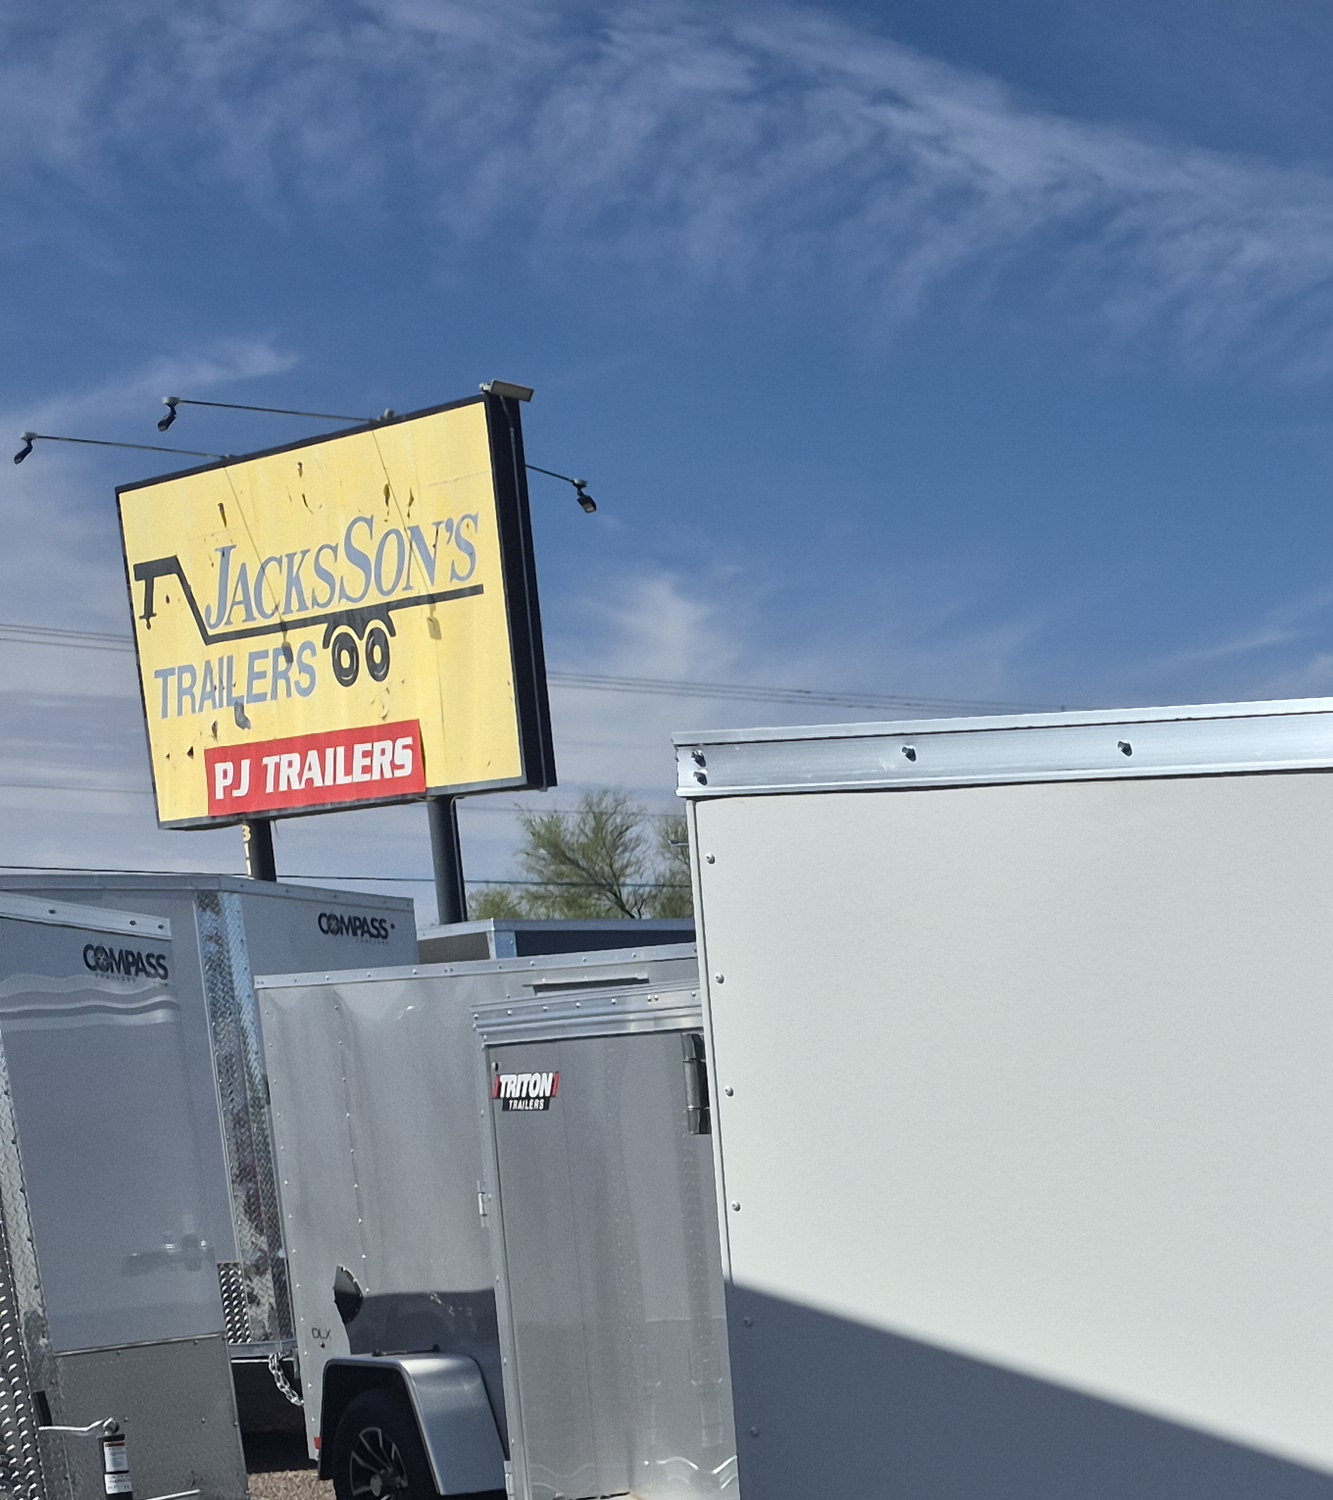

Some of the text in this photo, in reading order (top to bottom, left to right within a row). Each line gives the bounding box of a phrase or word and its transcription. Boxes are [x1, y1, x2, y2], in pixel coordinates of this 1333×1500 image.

[154, 640, 318, 719] TRAILERS
[214, 736, 414, 800] PJ TRAILERS
[318, 912, 389, 940] COMPASS
[83, 944, 169, 980] COMPASS
[499, 1072, 554, 1098] TRITON
[508, 1099, 545, 1111] TRAILERS
